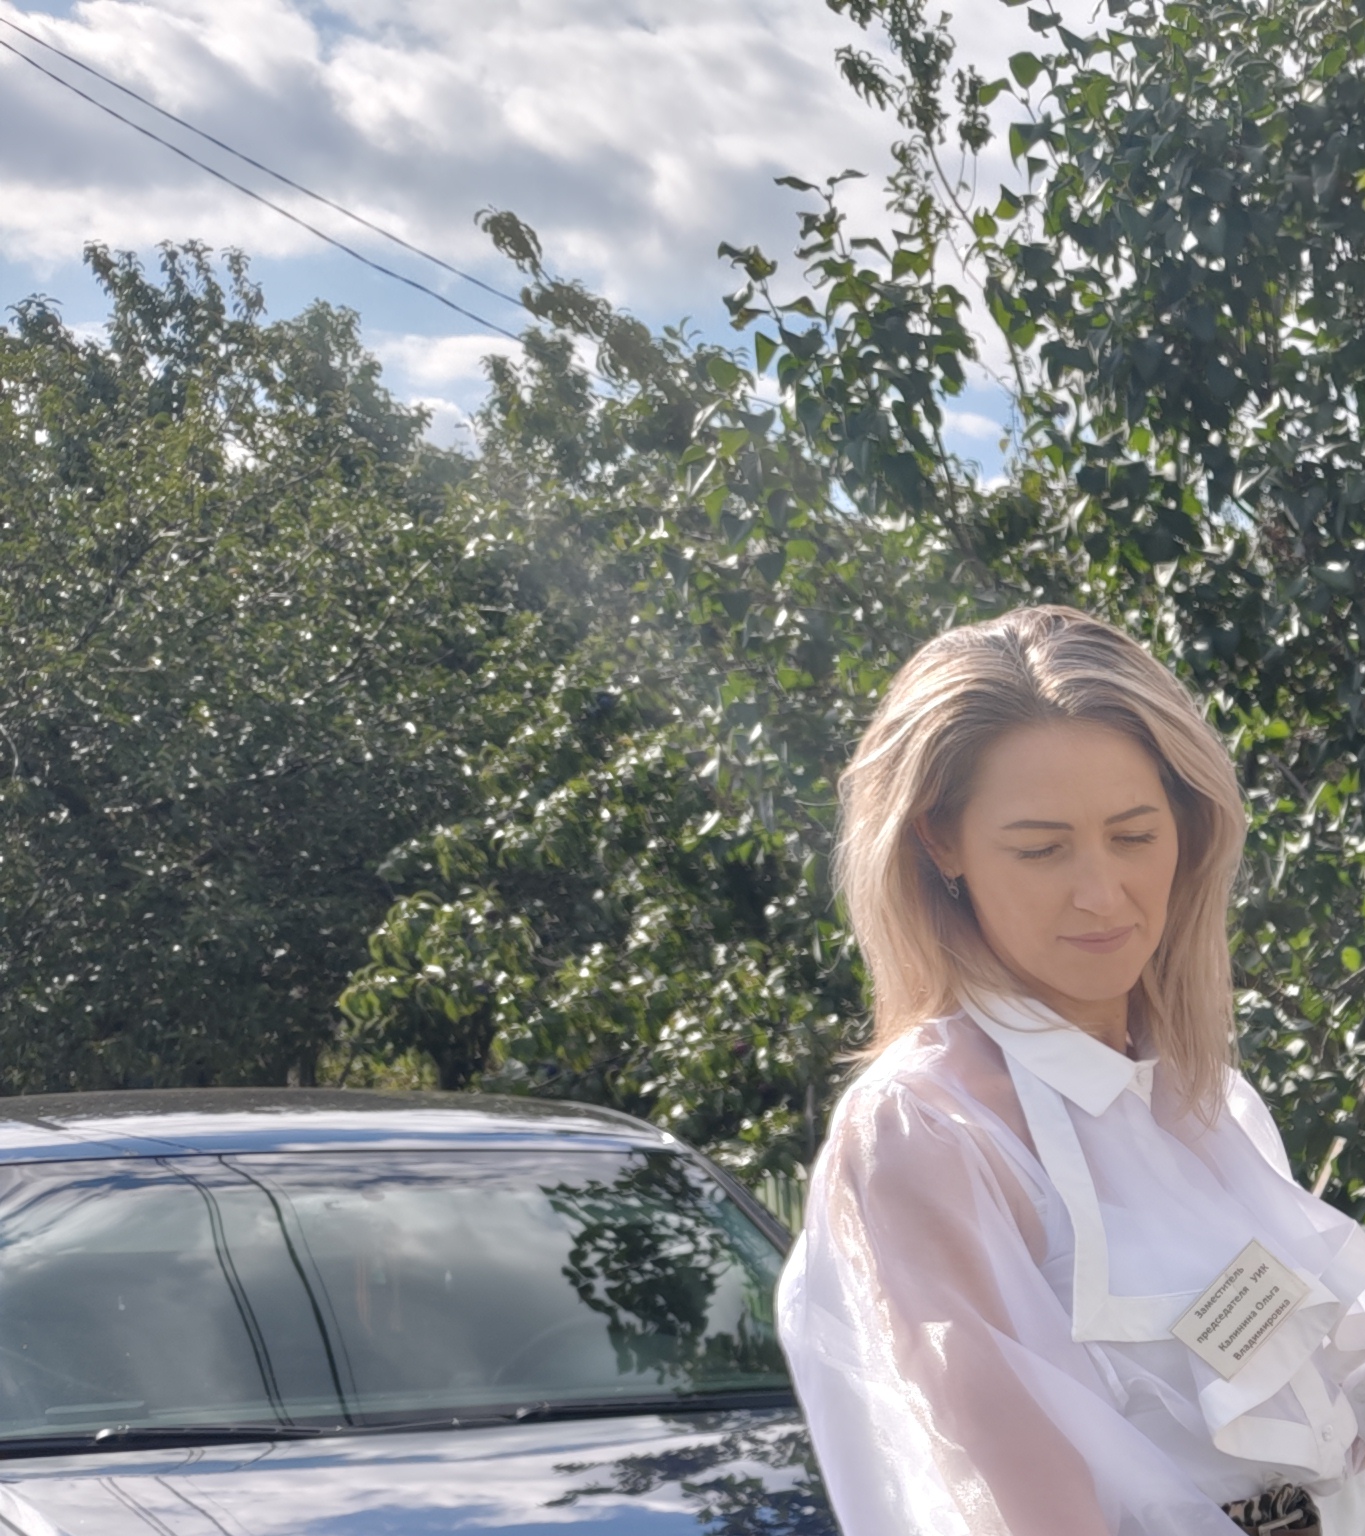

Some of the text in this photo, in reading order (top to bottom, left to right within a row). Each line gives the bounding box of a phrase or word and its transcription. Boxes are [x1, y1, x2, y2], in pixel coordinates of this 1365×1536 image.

[1194, 1266, 1245, 1319] Заместитель
[1196, 1262, 1270, 1344] председателя УИК
[1217, 1284, 1280, 1352] Калинина Ольга
[1232, 1298, 1291, 1361] Владимировна
